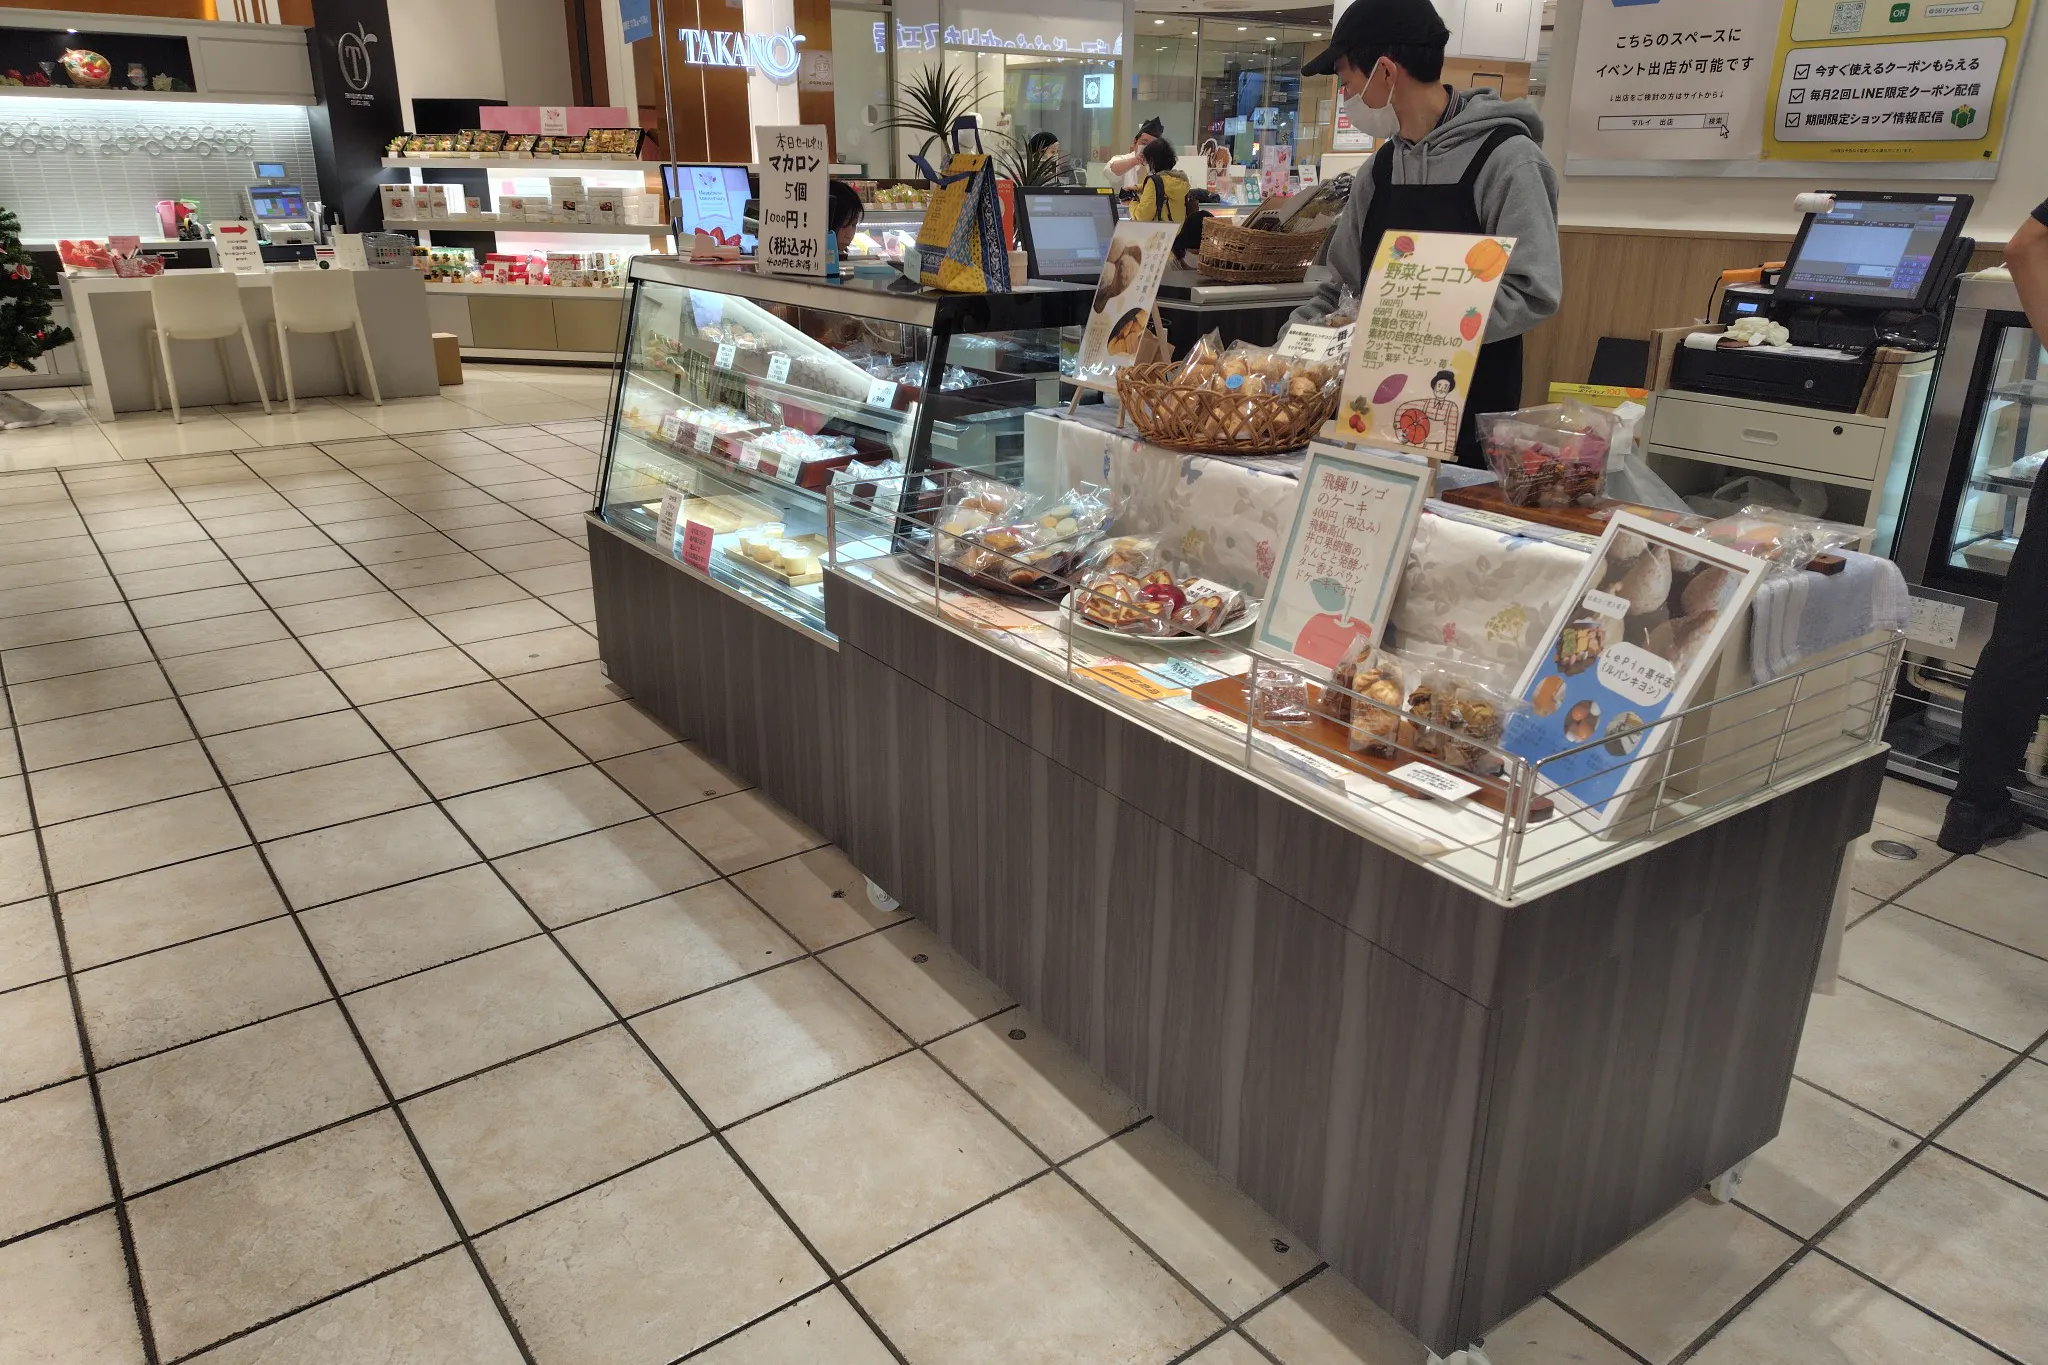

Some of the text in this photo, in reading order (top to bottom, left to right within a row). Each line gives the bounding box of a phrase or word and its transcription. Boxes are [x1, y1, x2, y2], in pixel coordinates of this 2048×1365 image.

[1892, 9, 1906, 18] OR
[1616, 28, 1742, 49] こちらのスペースに
[679, 26, 806, 78] TAKANO
[1596, 56, 1754, 78] イベント出店が可能です
[1815, 58, 1980, 78] 今すぐ使えるクーポンもらえる
[1810, 83, 1981, 102] 毎月2回LINE限定クーポン配信
[1659, 118, 1674, 126] 出店
[1708, 117, 1723, 125] 検索
[1805, 110, 1944, 126] 期間限定ショップ情報配信
[768, 154, 820, 173] マカロン
[784, 182, 807, 201] 5個
[765, 209, 808, 229] 1000円!
[768, 236, 818, 258] (税込み)
[1384, 262, 1483, 285] 野菜とココア
[1379, 281, 1441, 301] クッキー
[1367, 328, 1463, 347] 素材の自然な色合いの
[1326, 342, 1347, 356] です
[1361, 360, 1384, 370] ココア
[1321, 472, 1390, 500] 飛騨リンゴ
[1317, 492, 1368, 516] のケーキ
[1308, 518, 1347, 540] 飛騨高山
[1305, 531, 1361, 557] 井口果樹園の
[1303, 545, 1369, 572] りんごと発酵バ
